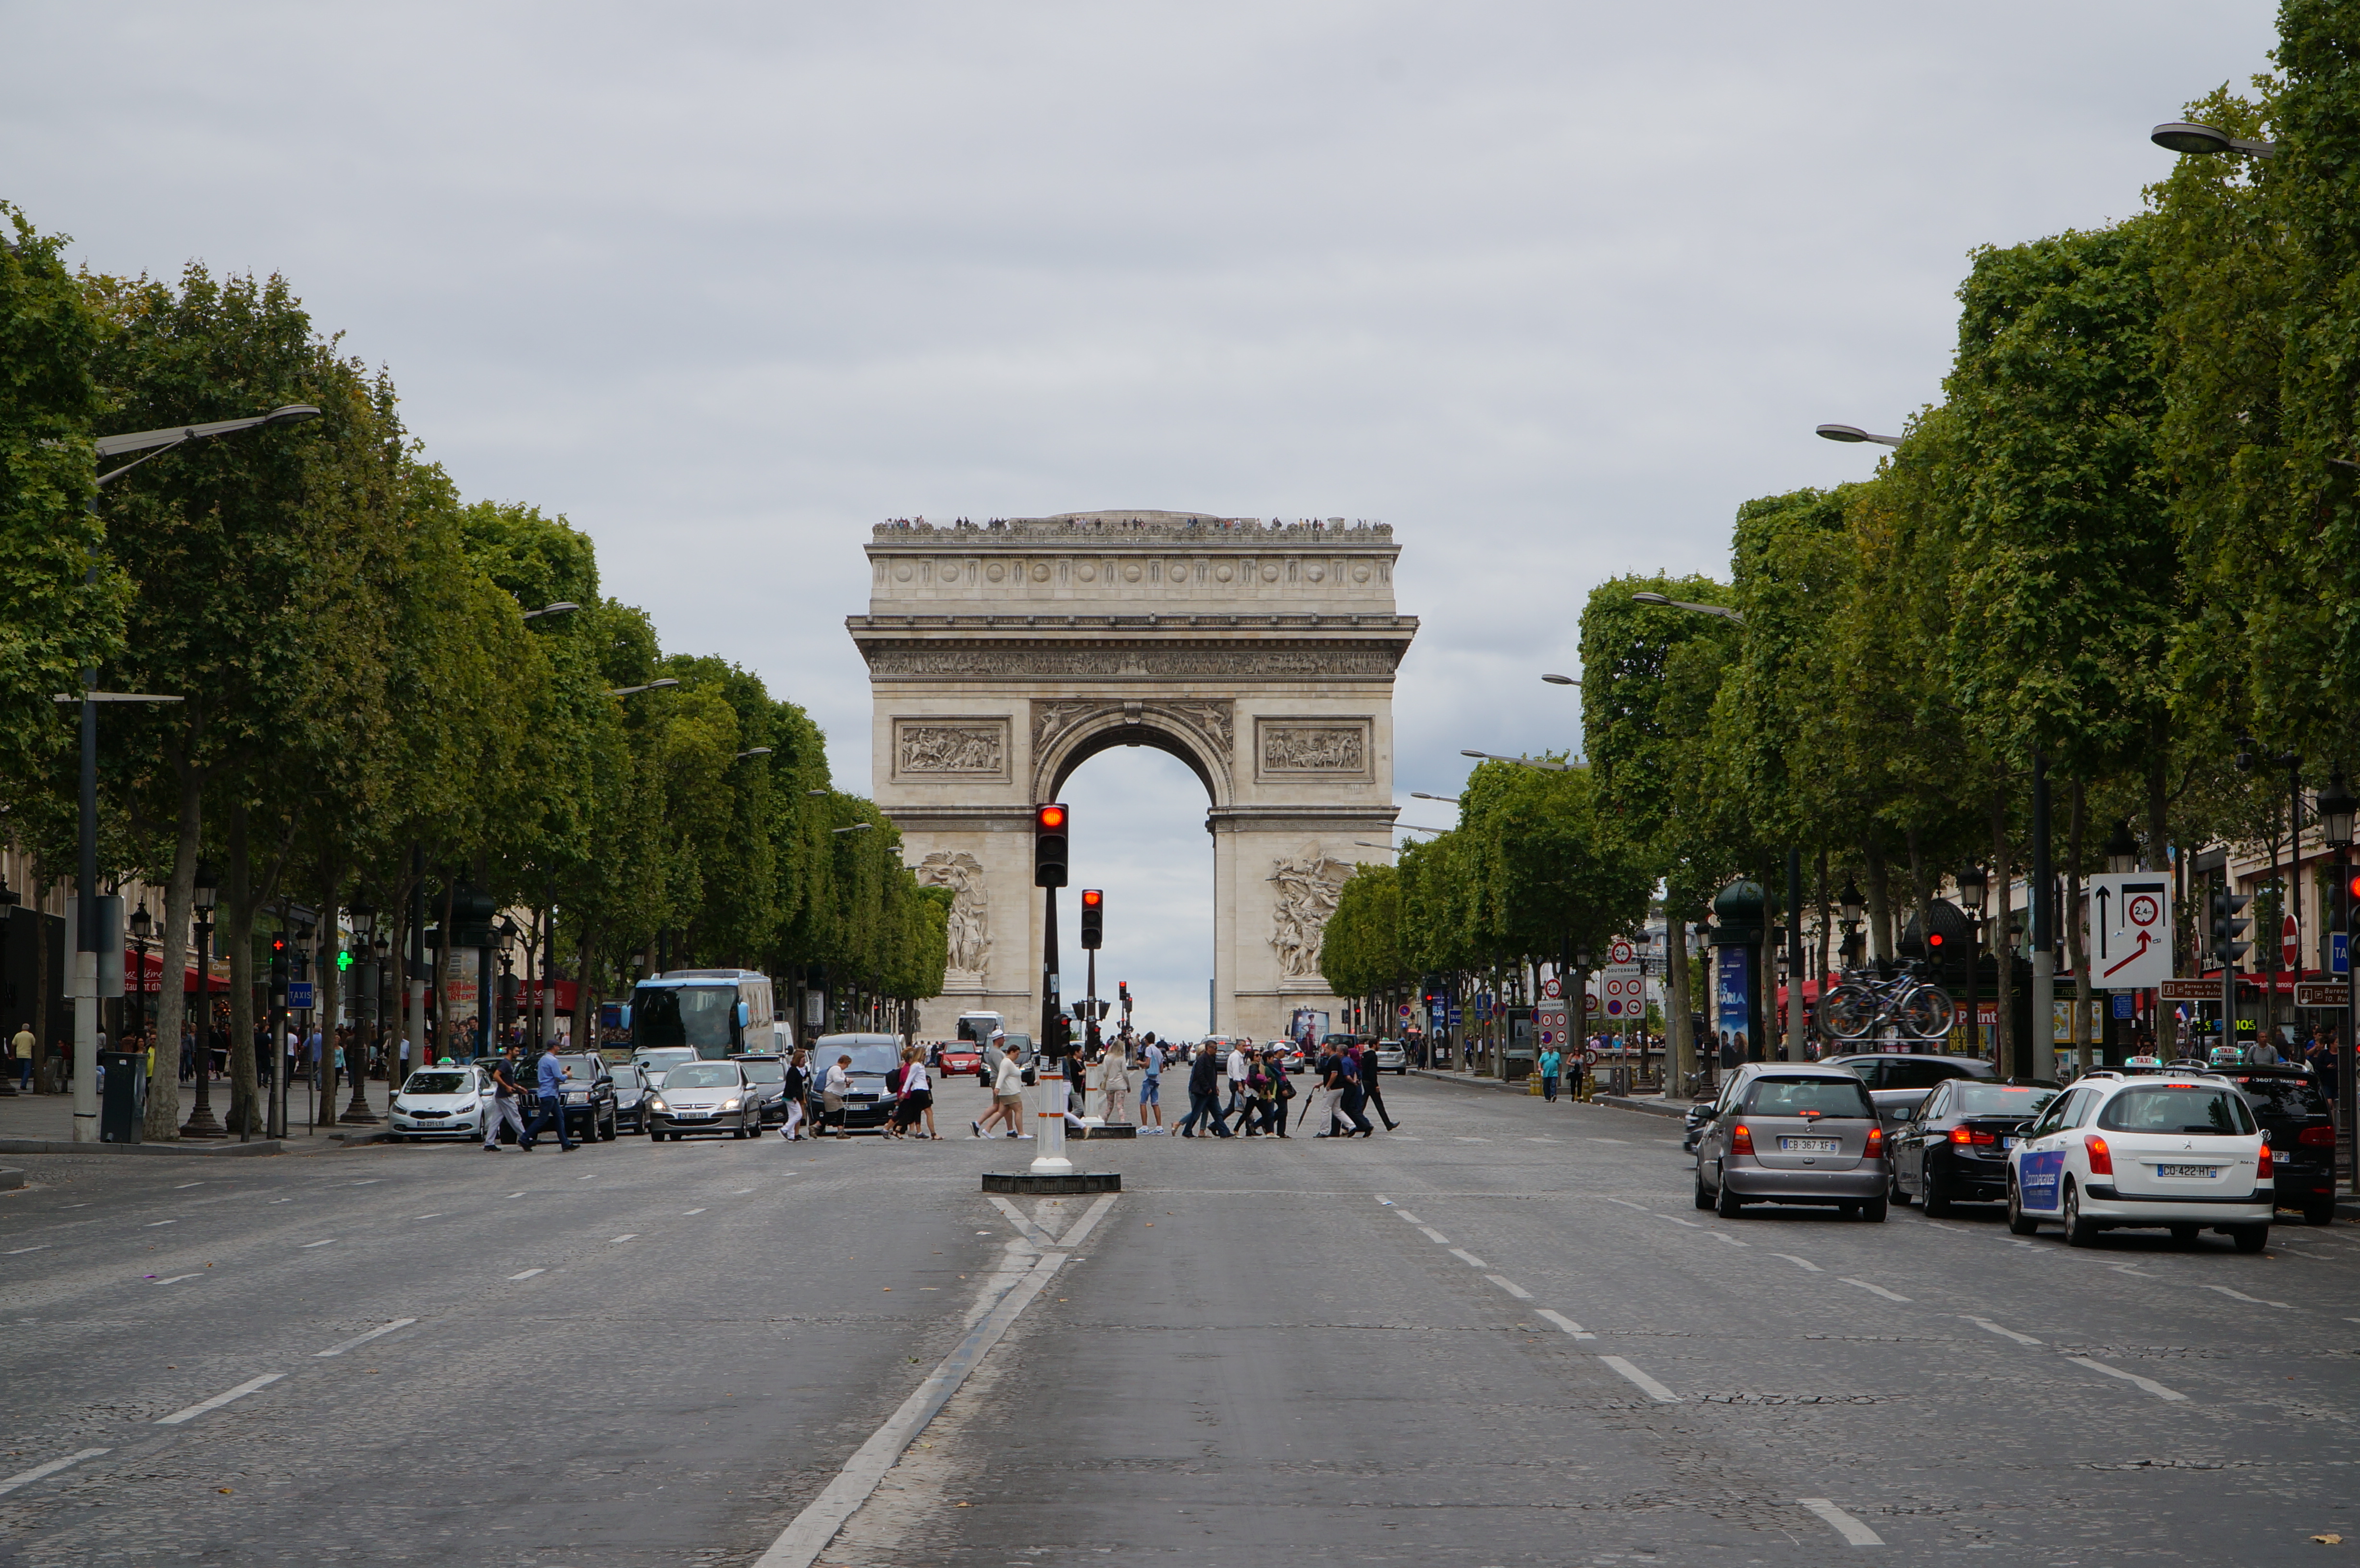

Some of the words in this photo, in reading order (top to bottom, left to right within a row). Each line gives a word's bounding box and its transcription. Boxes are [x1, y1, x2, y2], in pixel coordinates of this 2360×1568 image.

[2335, 947, 2348, 959] TA
[289, 991, 312, 999] TAXIS
[1958, 1009, 1997, 1023] Pint
[1950, 1039, 1961, 1051] DE
[1789, 1140, 1830, 1150] CB-367-XF
